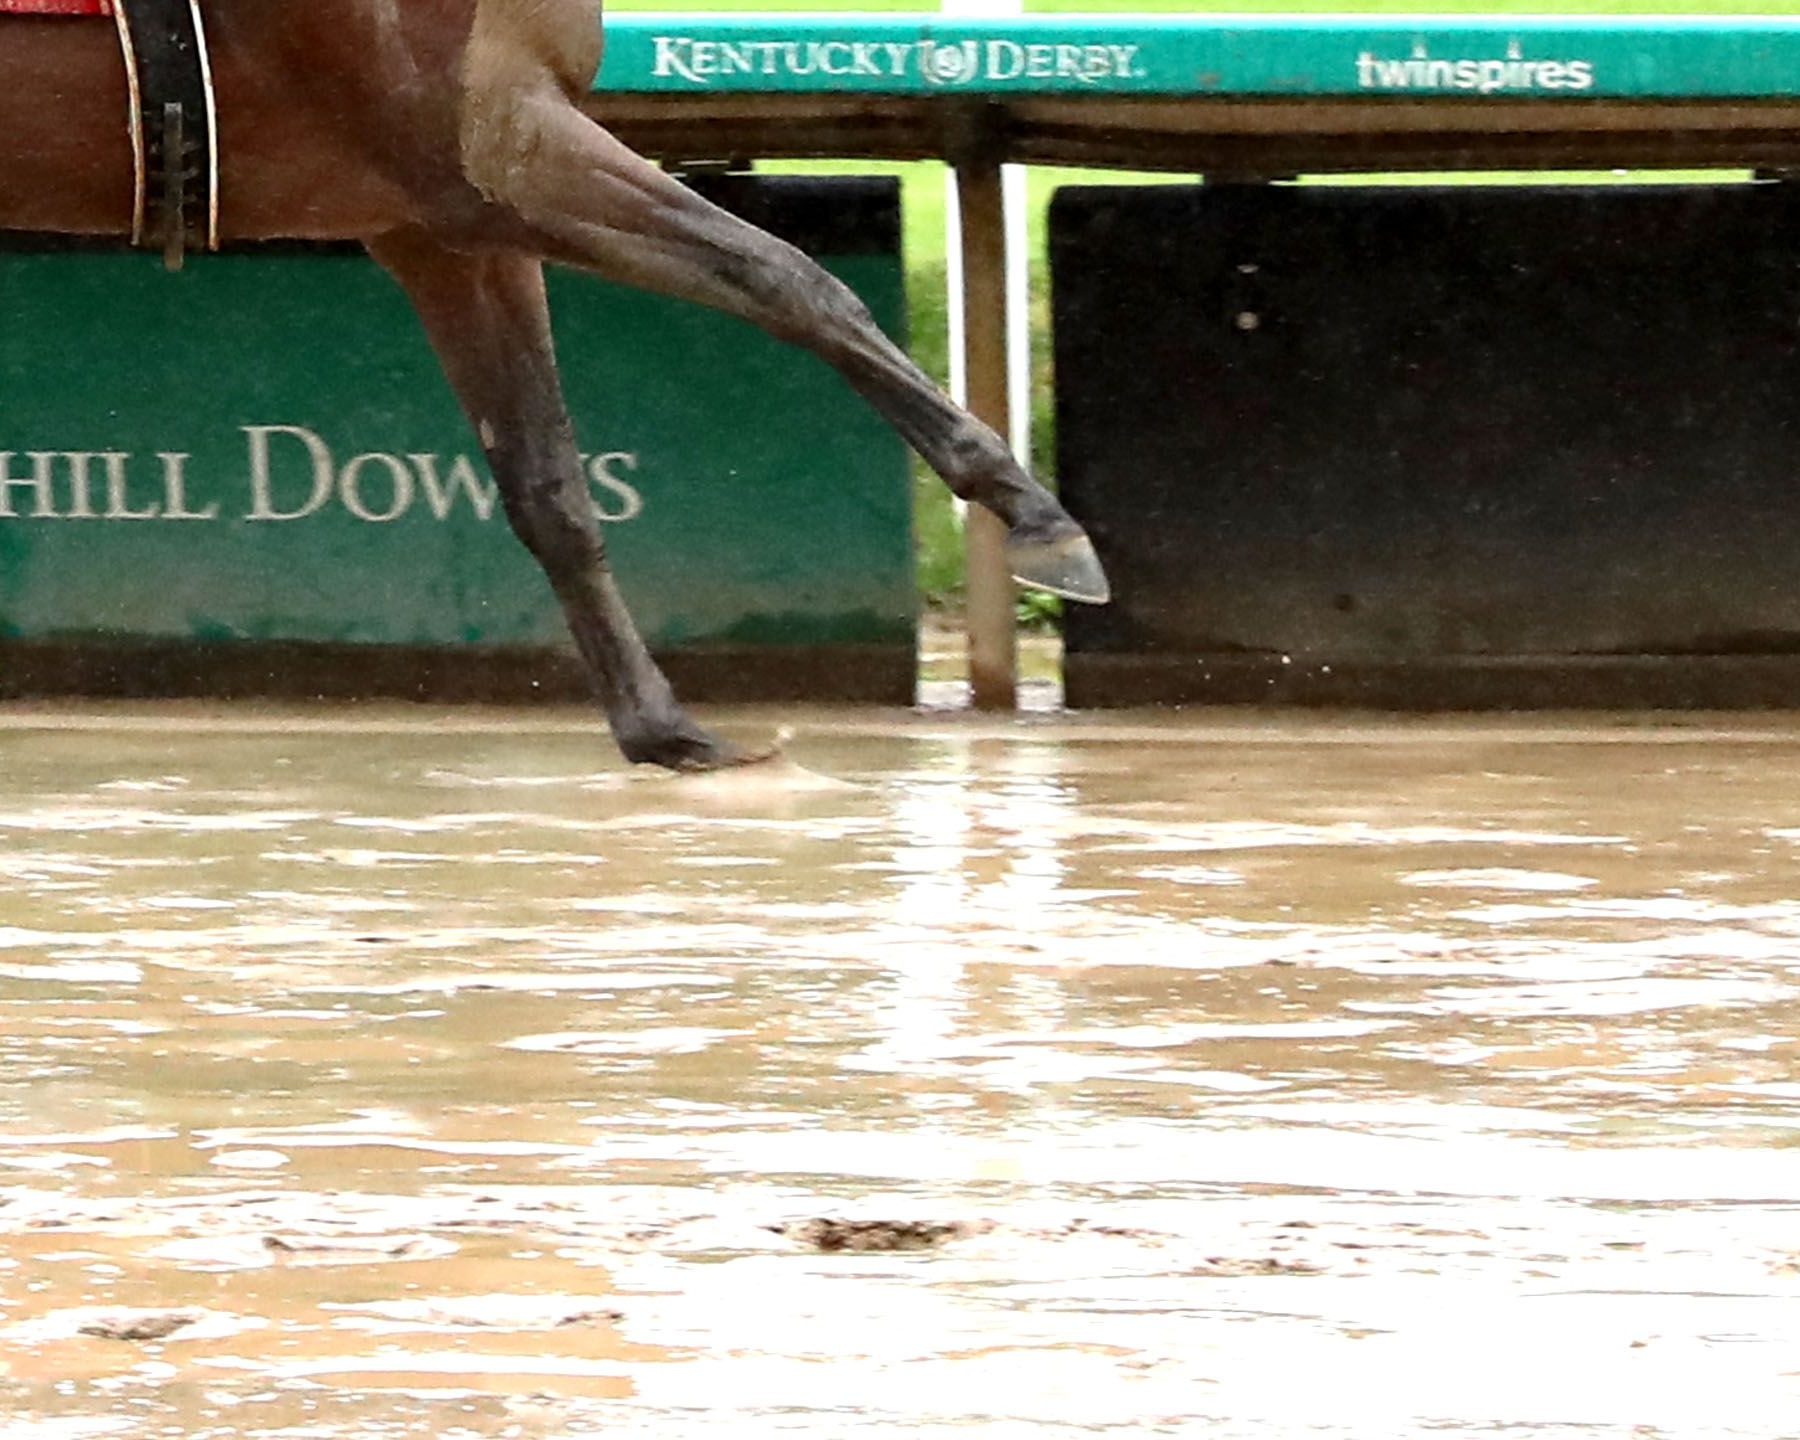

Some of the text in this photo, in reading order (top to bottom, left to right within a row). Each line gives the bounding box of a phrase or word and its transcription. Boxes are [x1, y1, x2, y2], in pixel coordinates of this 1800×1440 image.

[650, 36, 1140, 84] KENTUCKY DERBY
[1355, 37, 1593, 94] twinspires
[241, 423, 643, 522] DOWS
